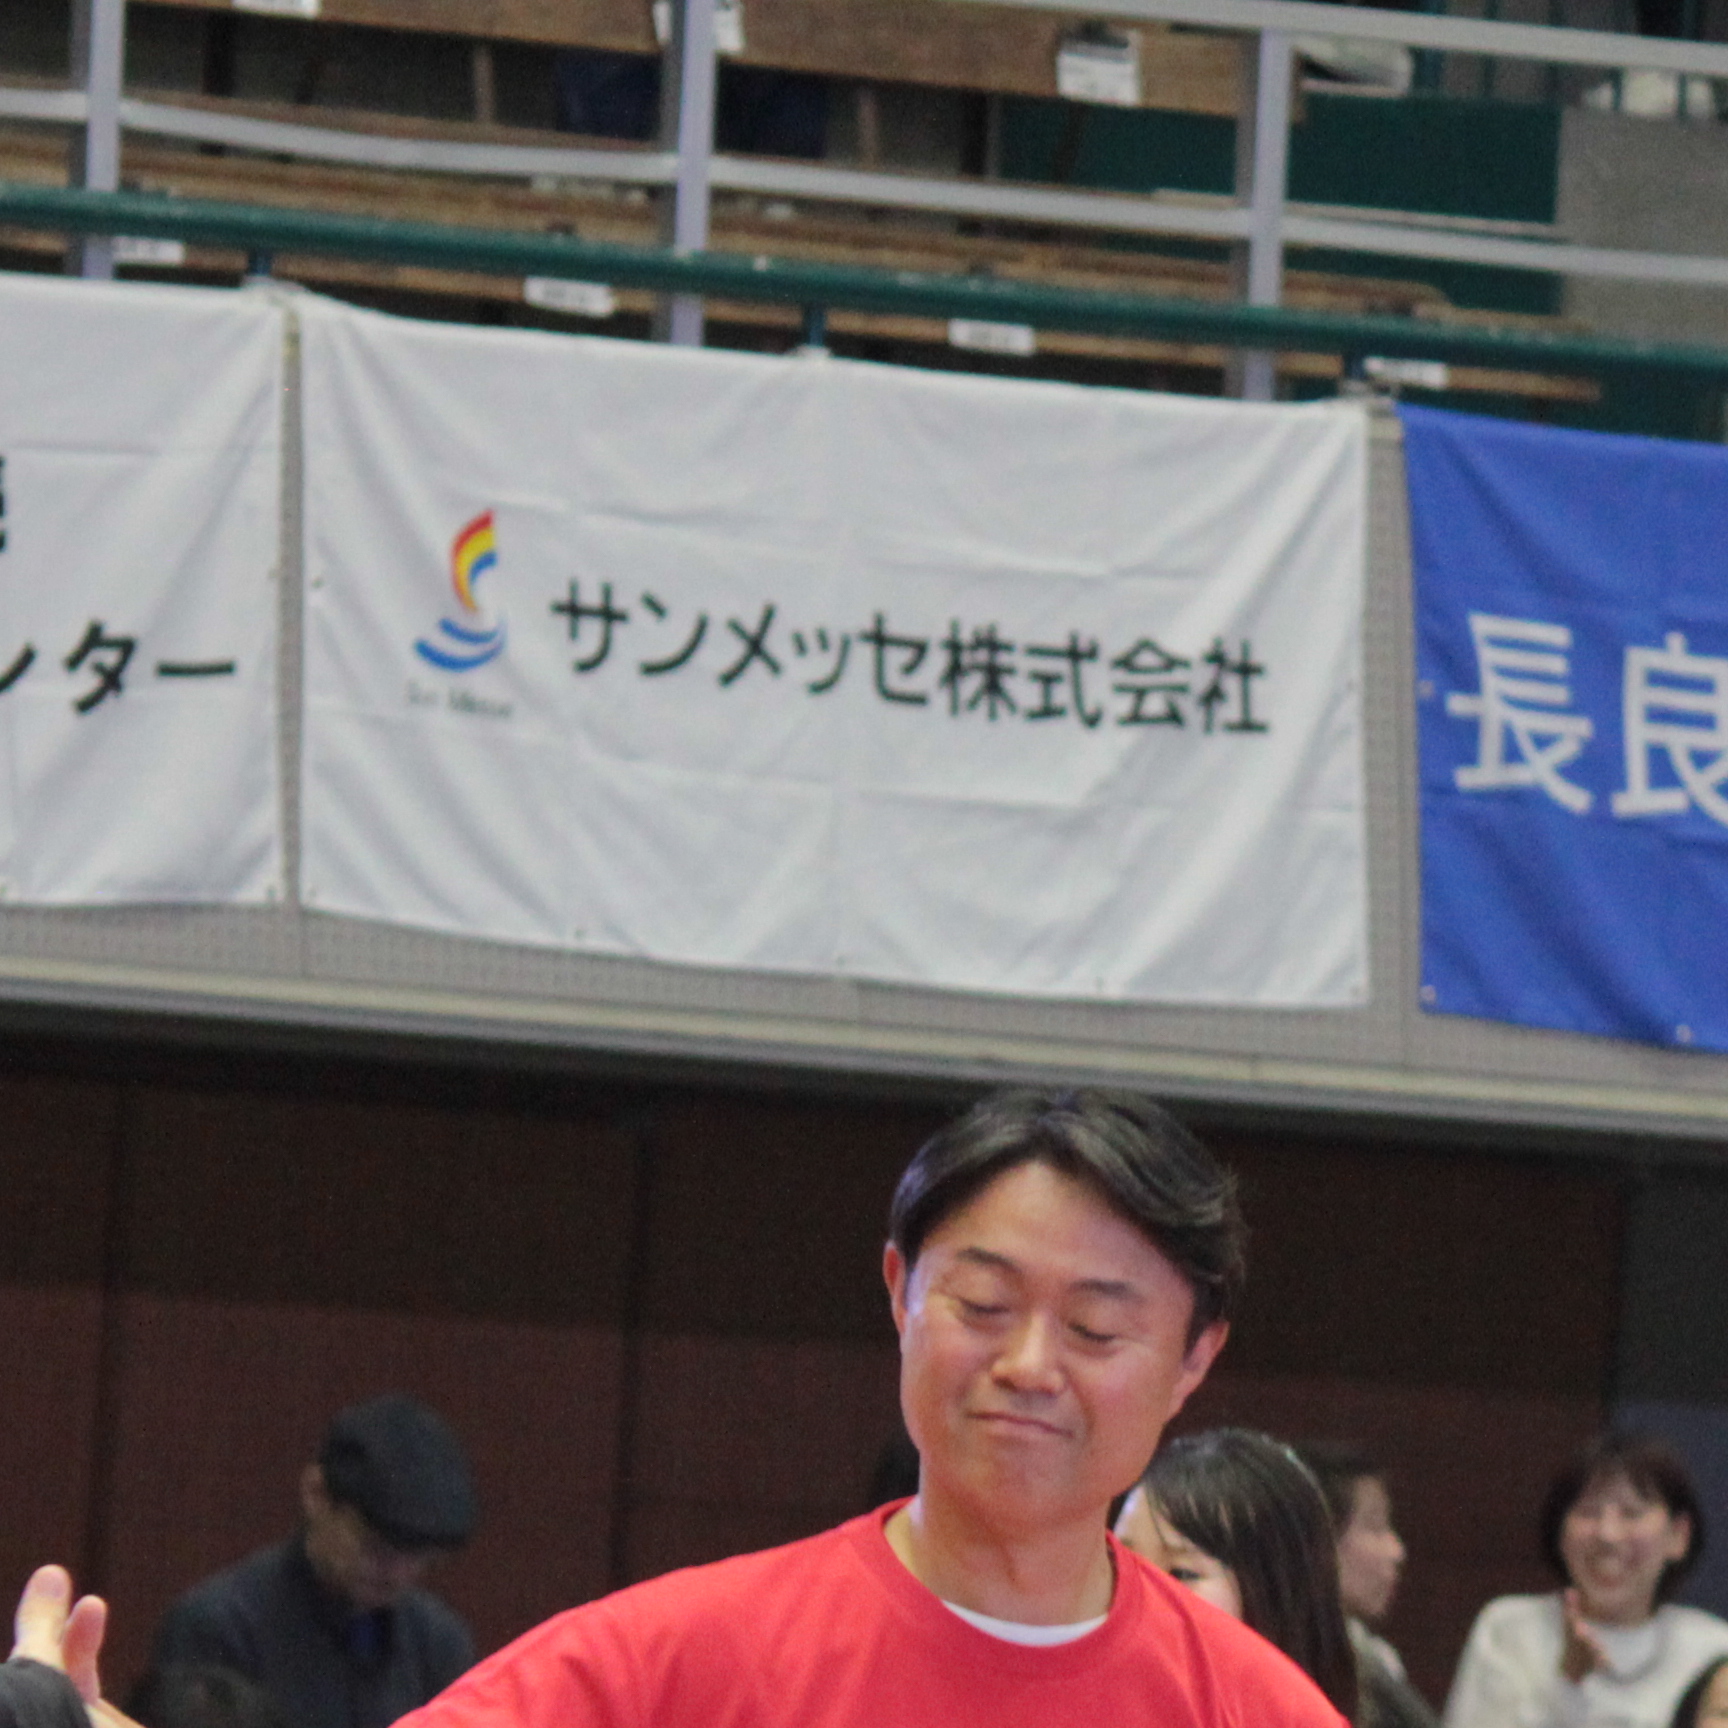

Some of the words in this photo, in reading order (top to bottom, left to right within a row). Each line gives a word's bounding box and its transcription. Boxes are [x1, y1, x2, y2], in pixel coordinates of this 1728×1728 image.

[551, 580, 1270, 737] サンメッセ株式会社
